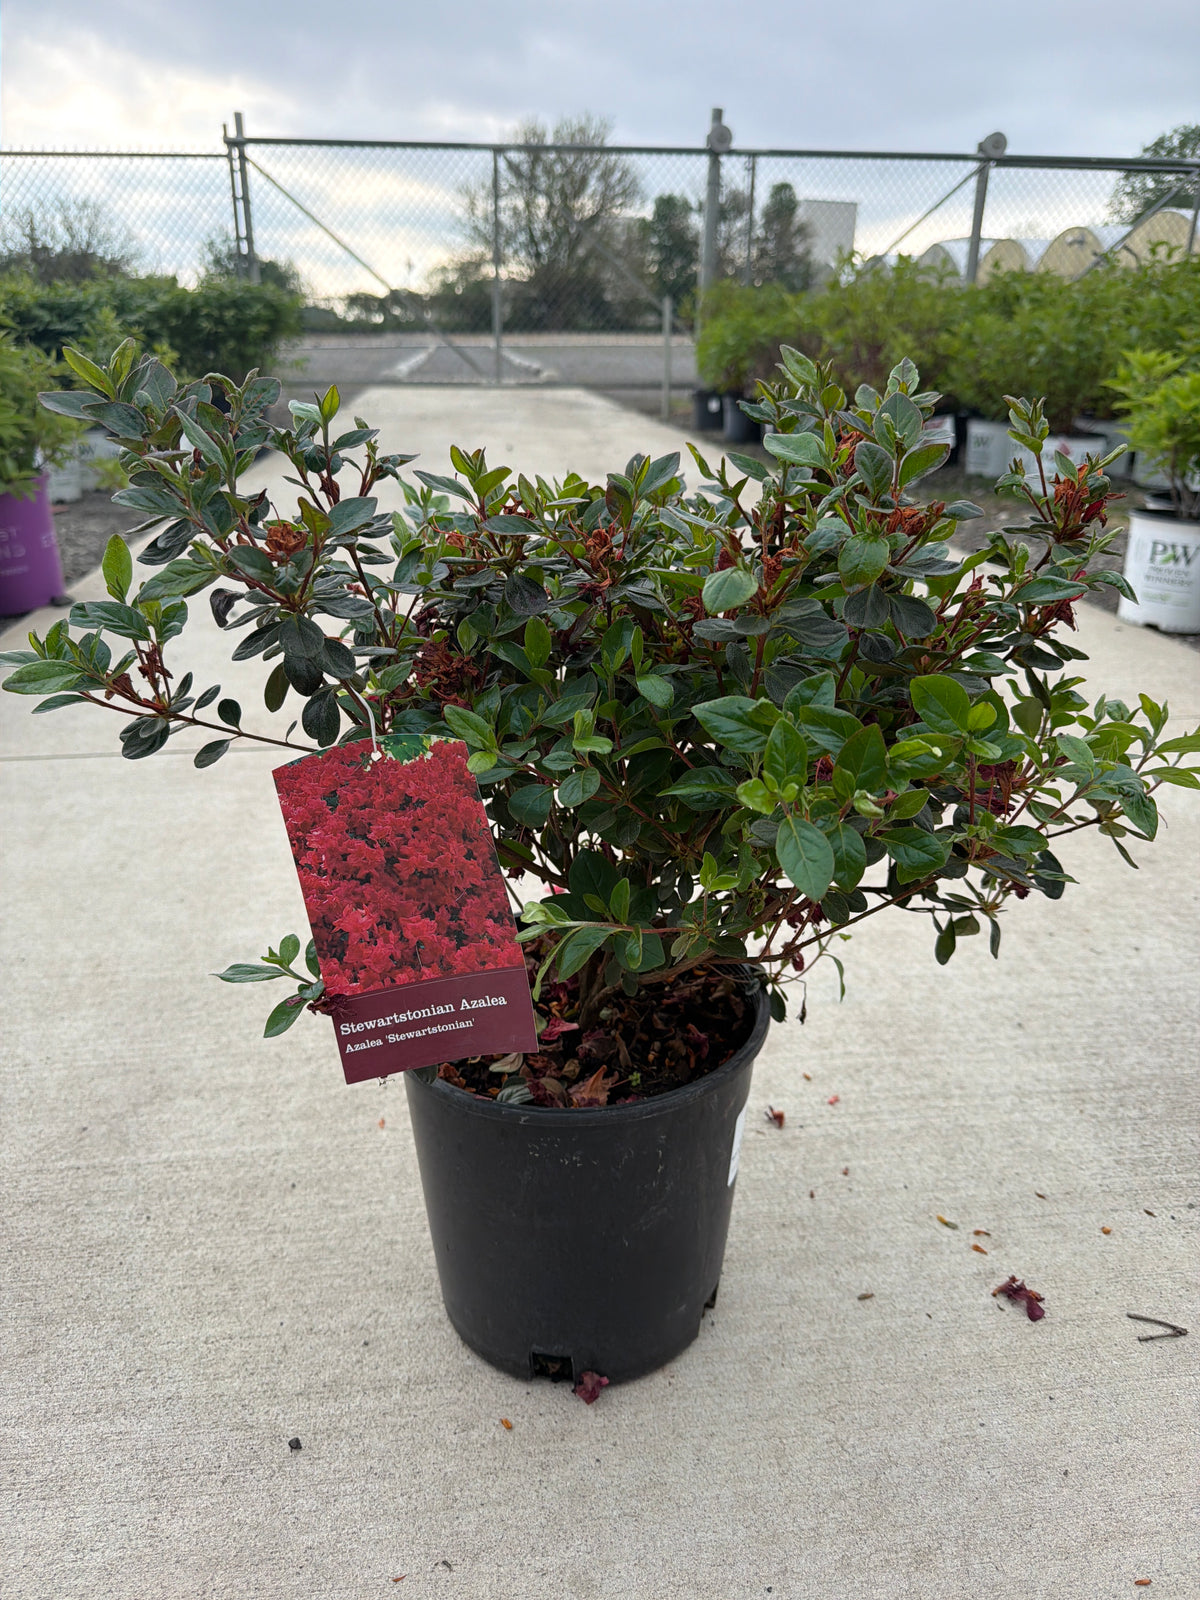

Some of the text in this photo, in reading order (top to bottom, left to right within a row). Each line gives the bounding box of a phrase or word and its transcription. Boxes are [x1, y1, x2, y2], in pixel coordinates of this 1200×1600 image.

[340, 995, 507, 1036] Stewartstonian Azalea
[345, 1018, 476, 1053] Azalea 'Stewartstonian'
